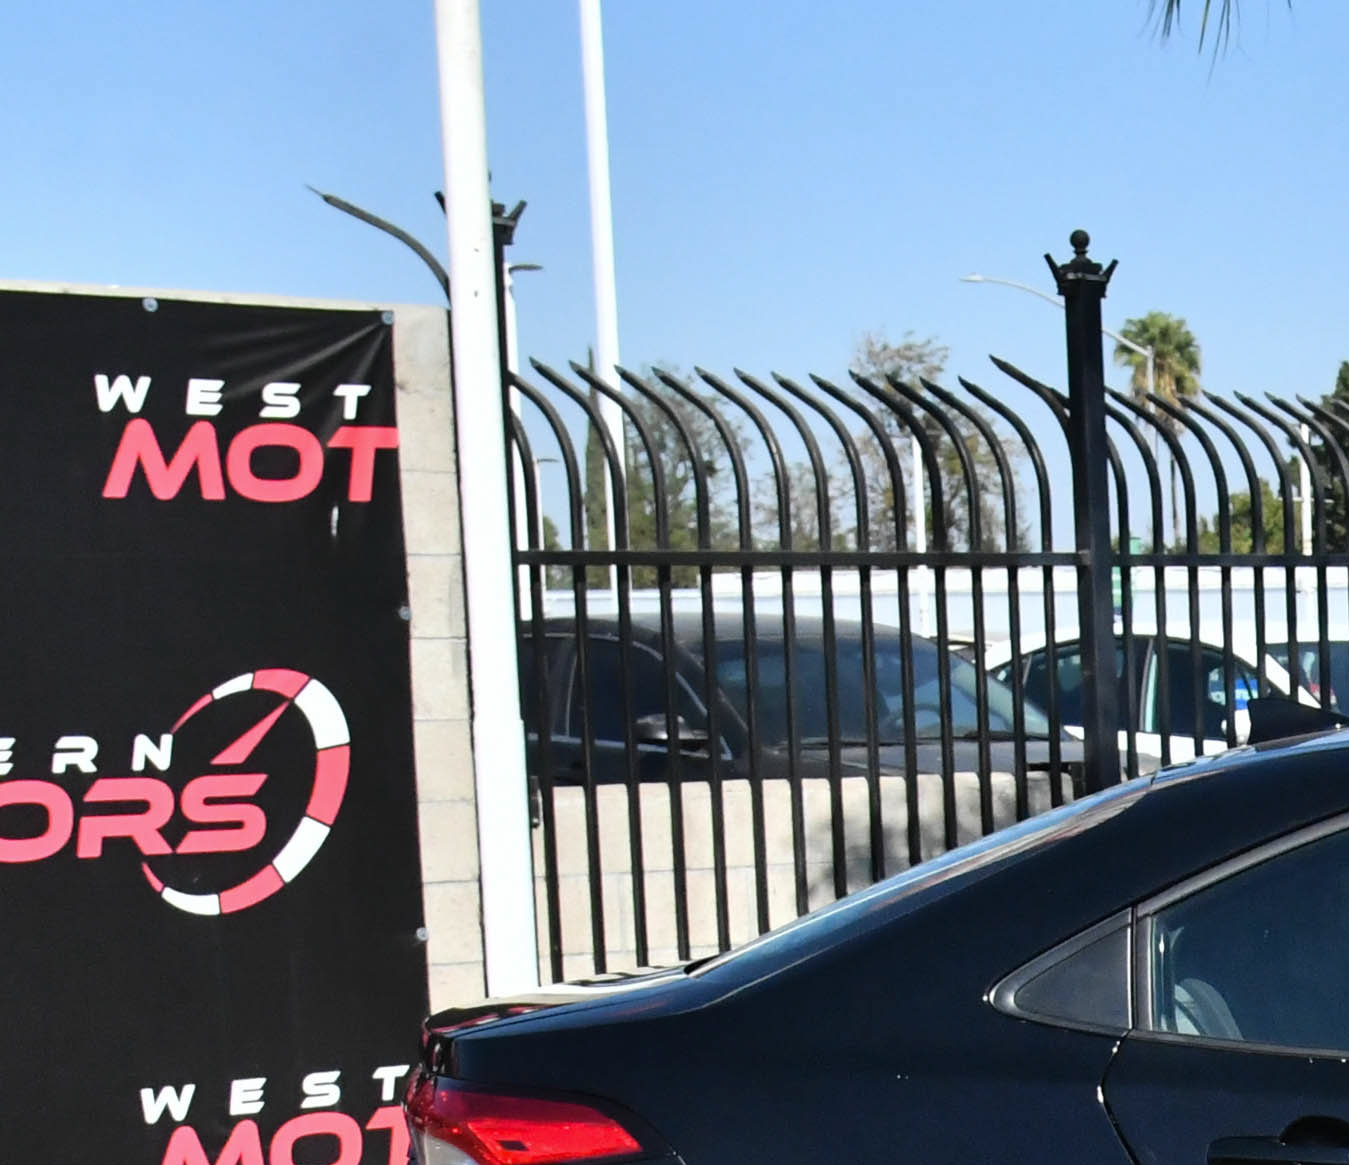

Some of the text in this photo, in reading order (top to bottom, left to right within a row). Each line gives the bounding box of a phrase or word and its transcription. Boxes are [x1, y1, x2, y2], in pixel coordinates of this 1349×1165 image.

[95, 374, 371, 419] WEST
[102, 418, 400, 502] MOT
[140, 1065, 409, 1124] WEST
